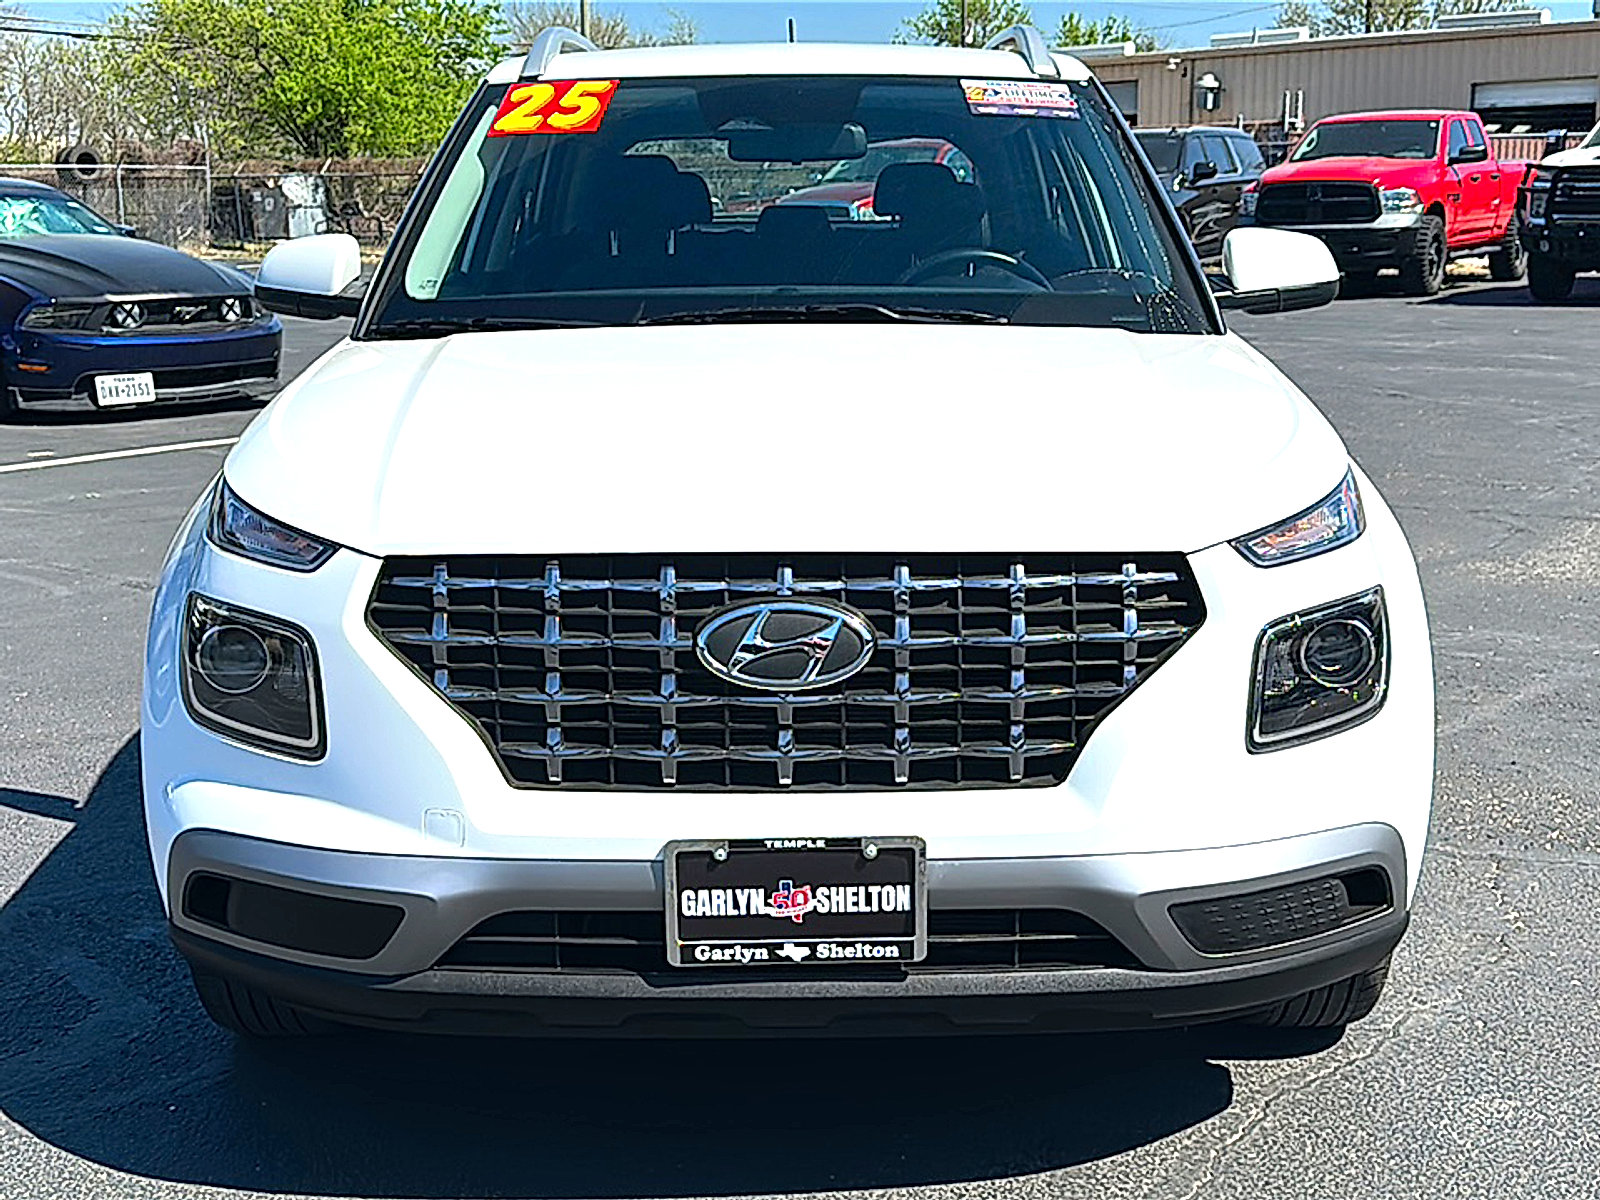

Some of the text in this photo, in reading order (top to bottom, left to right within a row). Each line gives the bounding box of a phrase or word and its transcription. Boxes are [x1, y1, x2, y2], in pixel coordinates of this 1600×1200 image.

[494, 81, 613, 132] 25
[764, 839, 826, 849] TEMPLE
[681, 888, 765, 917] GARLYN
[815, 885, 911, 914] SHELTON
[694, 944, 900, 964] Garlyn Shelton
